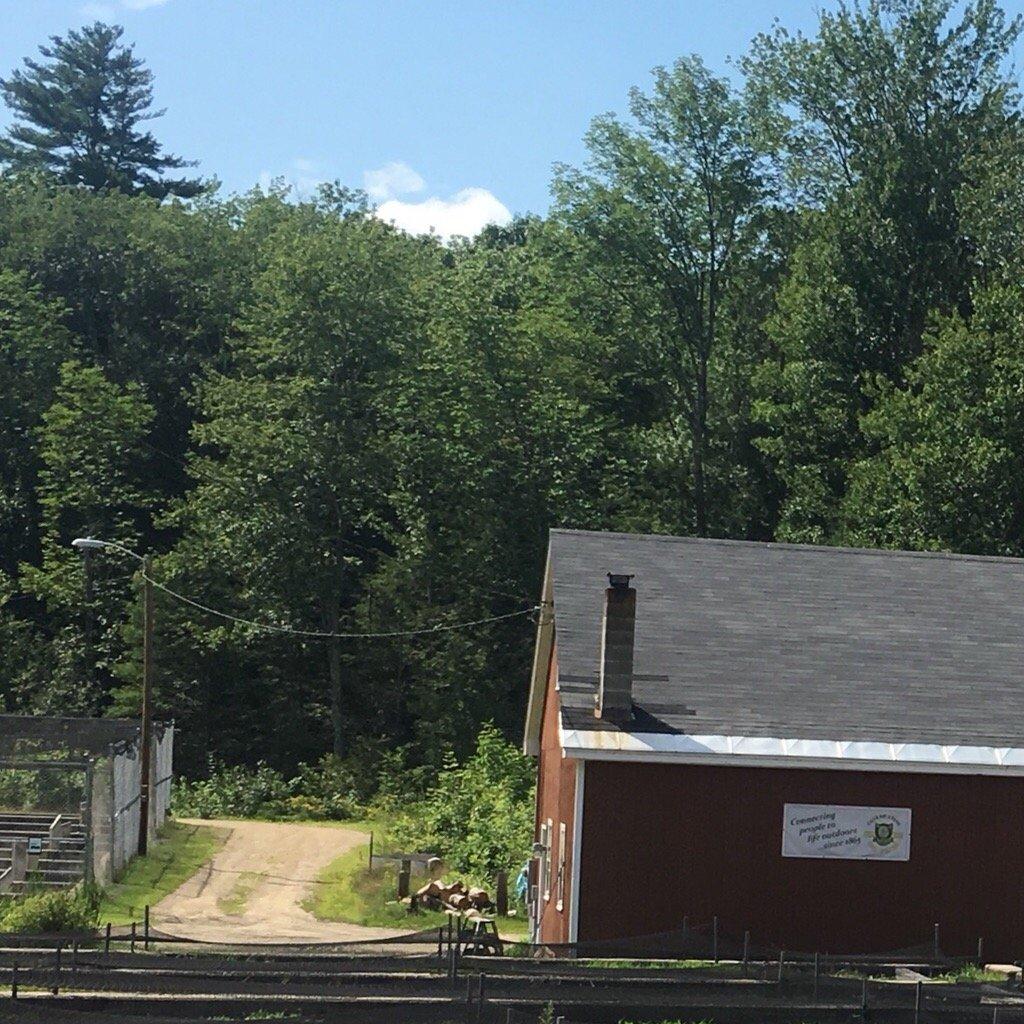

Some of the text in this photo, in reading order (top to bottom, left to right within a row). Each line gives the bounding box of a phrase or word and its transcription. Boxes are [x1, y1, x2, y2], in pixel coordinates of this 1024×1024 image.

[790, 812, 836, 826] Connecting
[799, 823, 826, 836] people
[807, 828, 858, 843] life outdoors
